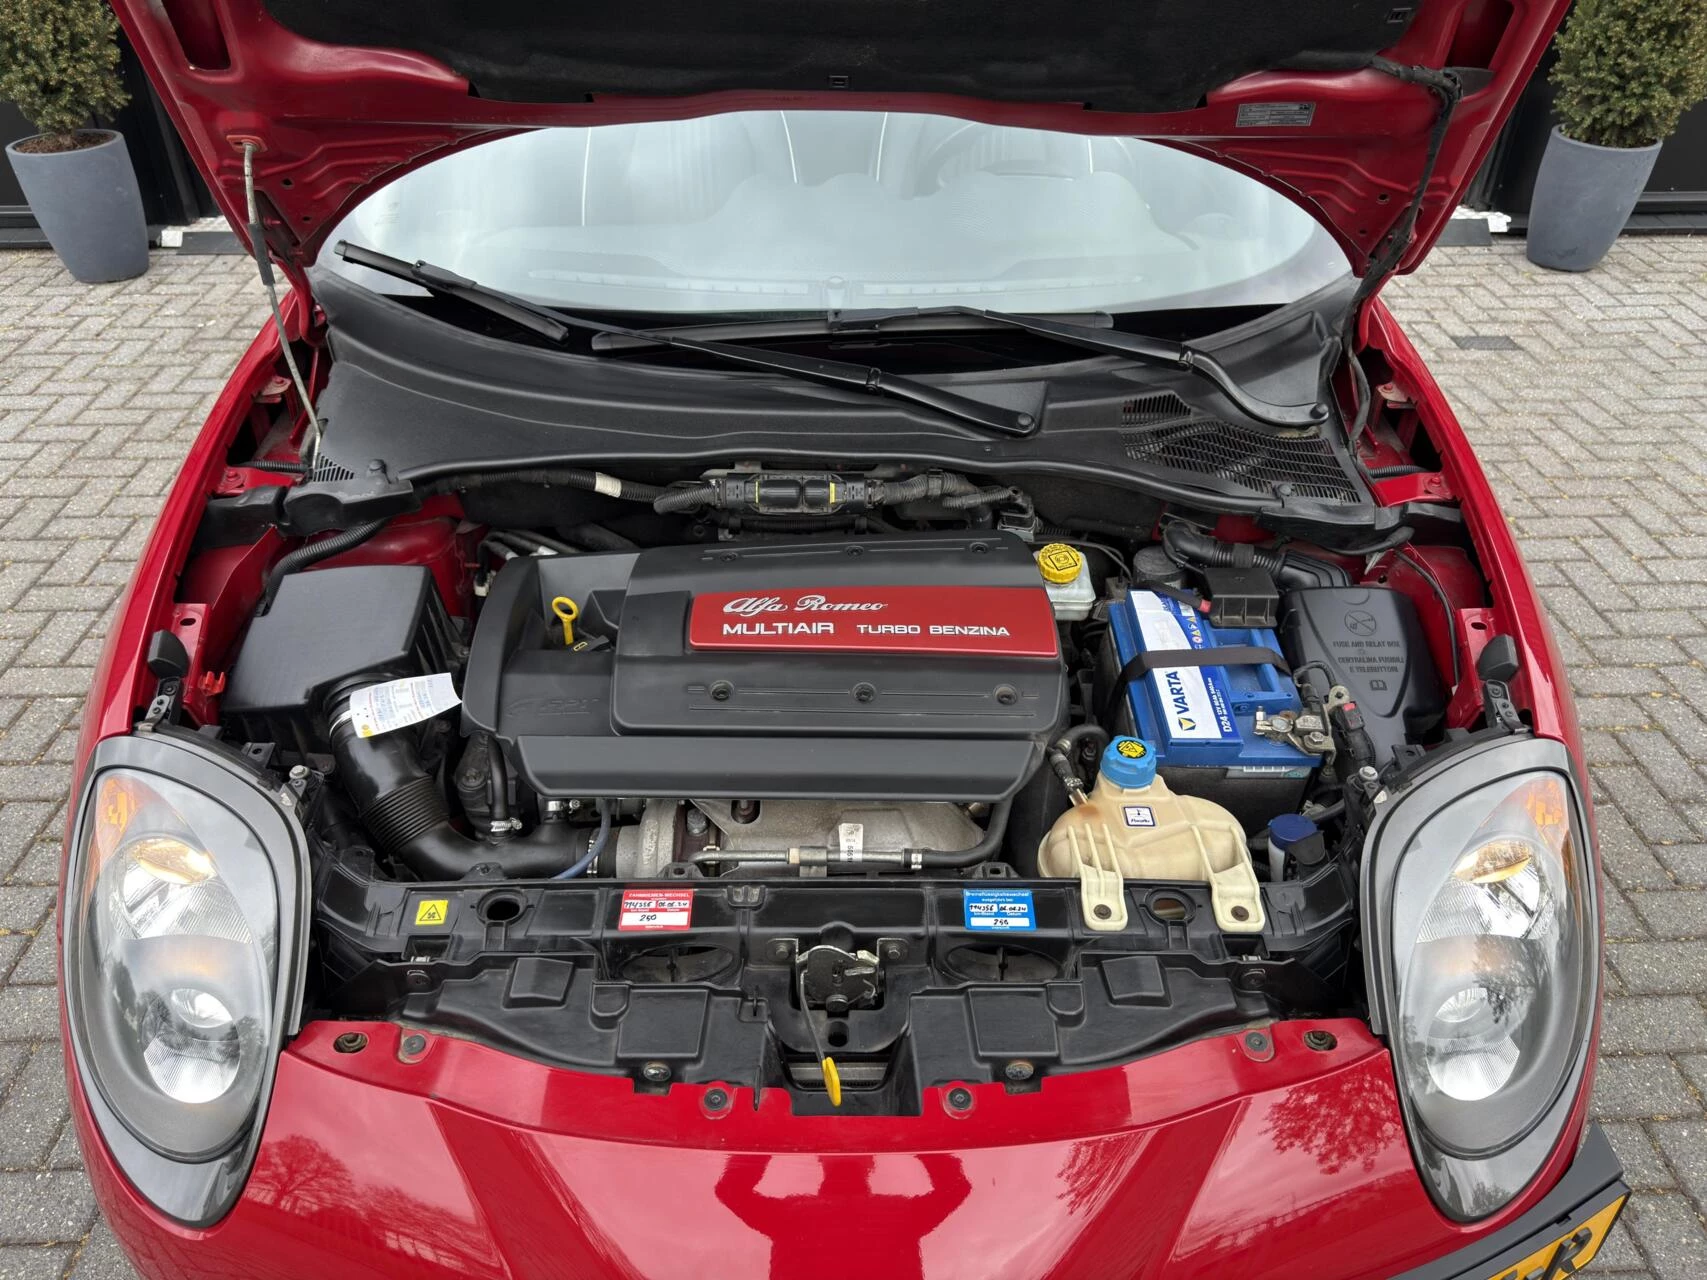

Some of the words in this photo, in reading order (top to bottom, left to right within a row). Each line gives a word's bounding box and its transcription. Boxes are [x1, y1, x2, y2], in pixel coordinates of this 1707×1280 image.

[722, 597, 788, 617] Alfa
[793, 594, 888, 612] Romeo
[722, 622, 834, 635] MULTIAIR
[857, 624, 921, 635] TURBO
[929, 625, 1010, 636] BENZINA
[1165, 671, 1189, 714] VARTA
[1220, 716, 1232, 733] D24
